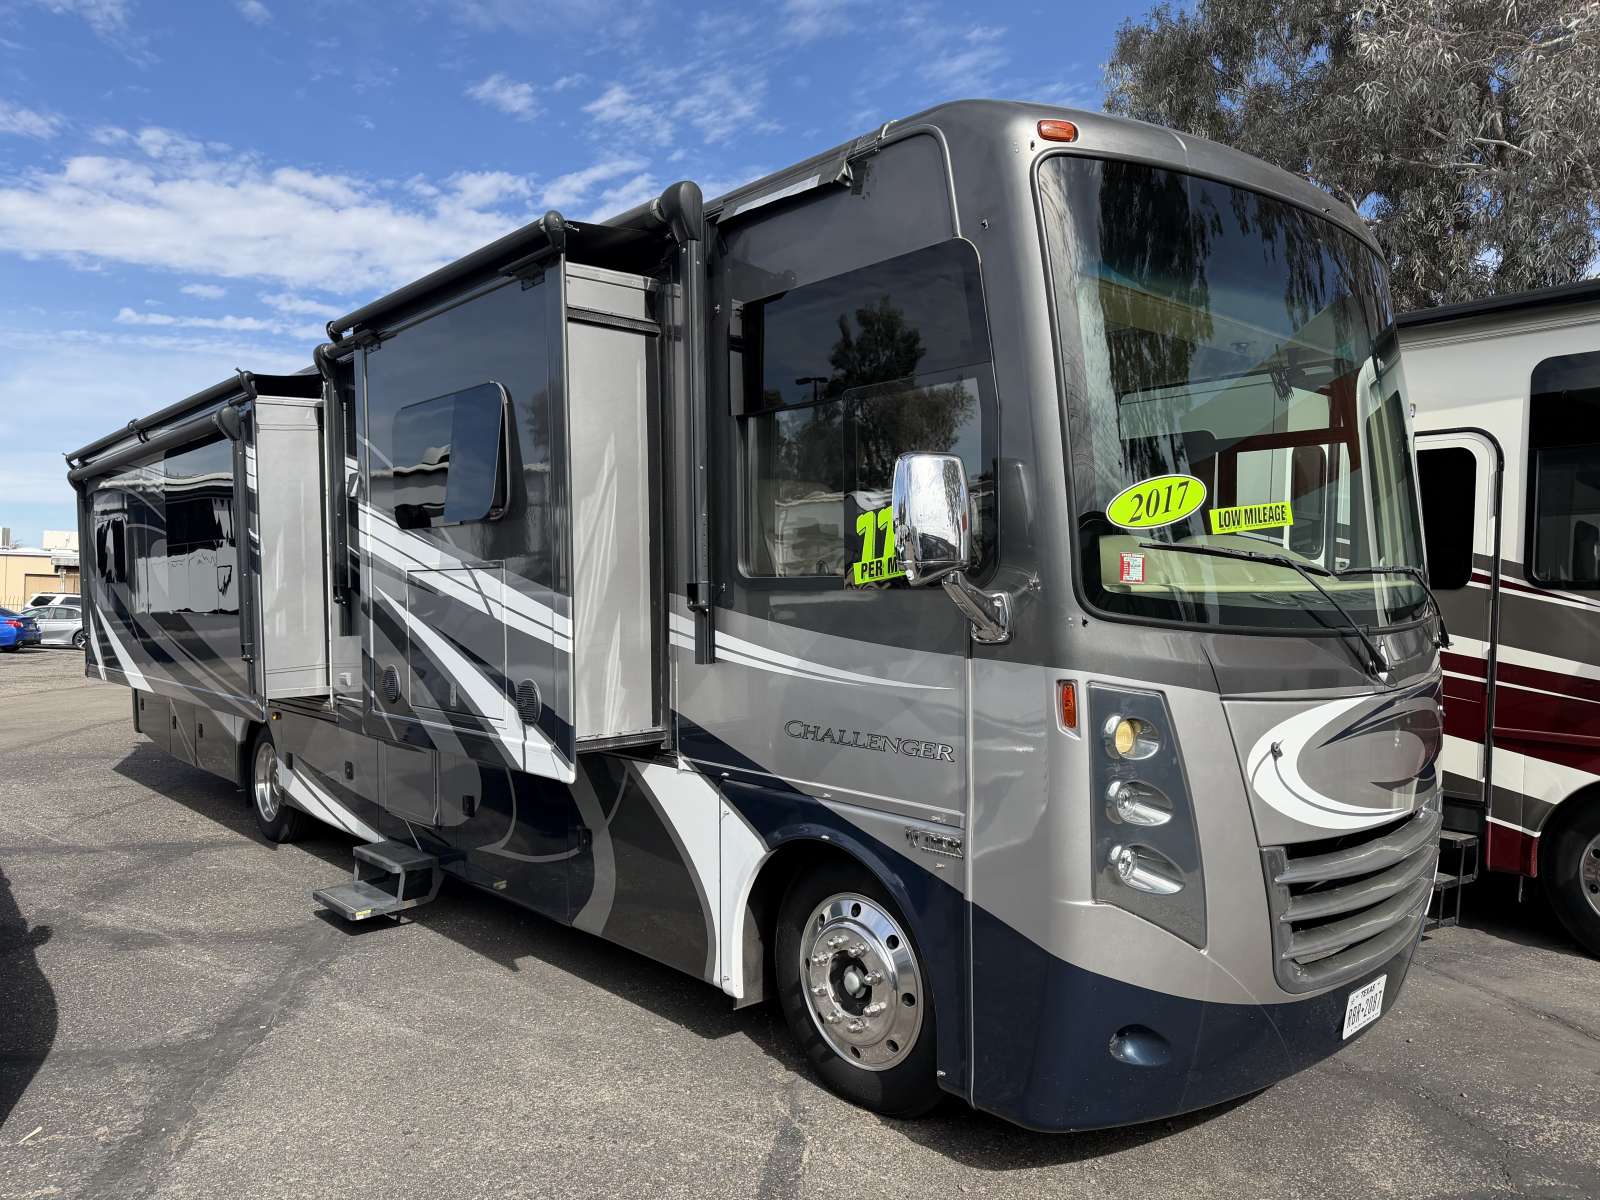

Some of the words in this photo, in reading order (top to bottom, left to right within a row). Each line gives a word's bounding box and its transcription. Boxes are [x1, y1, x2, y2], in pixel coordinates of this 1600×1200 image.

[1128, 481, 1190, 523] 2017
[1218, 510, 1241, 528] LOW
[1244, 505, 1286, 525] MILEAGE
[861, 560, 883, 579] PER
[784, 720, 956, 763] CHALLENGER
